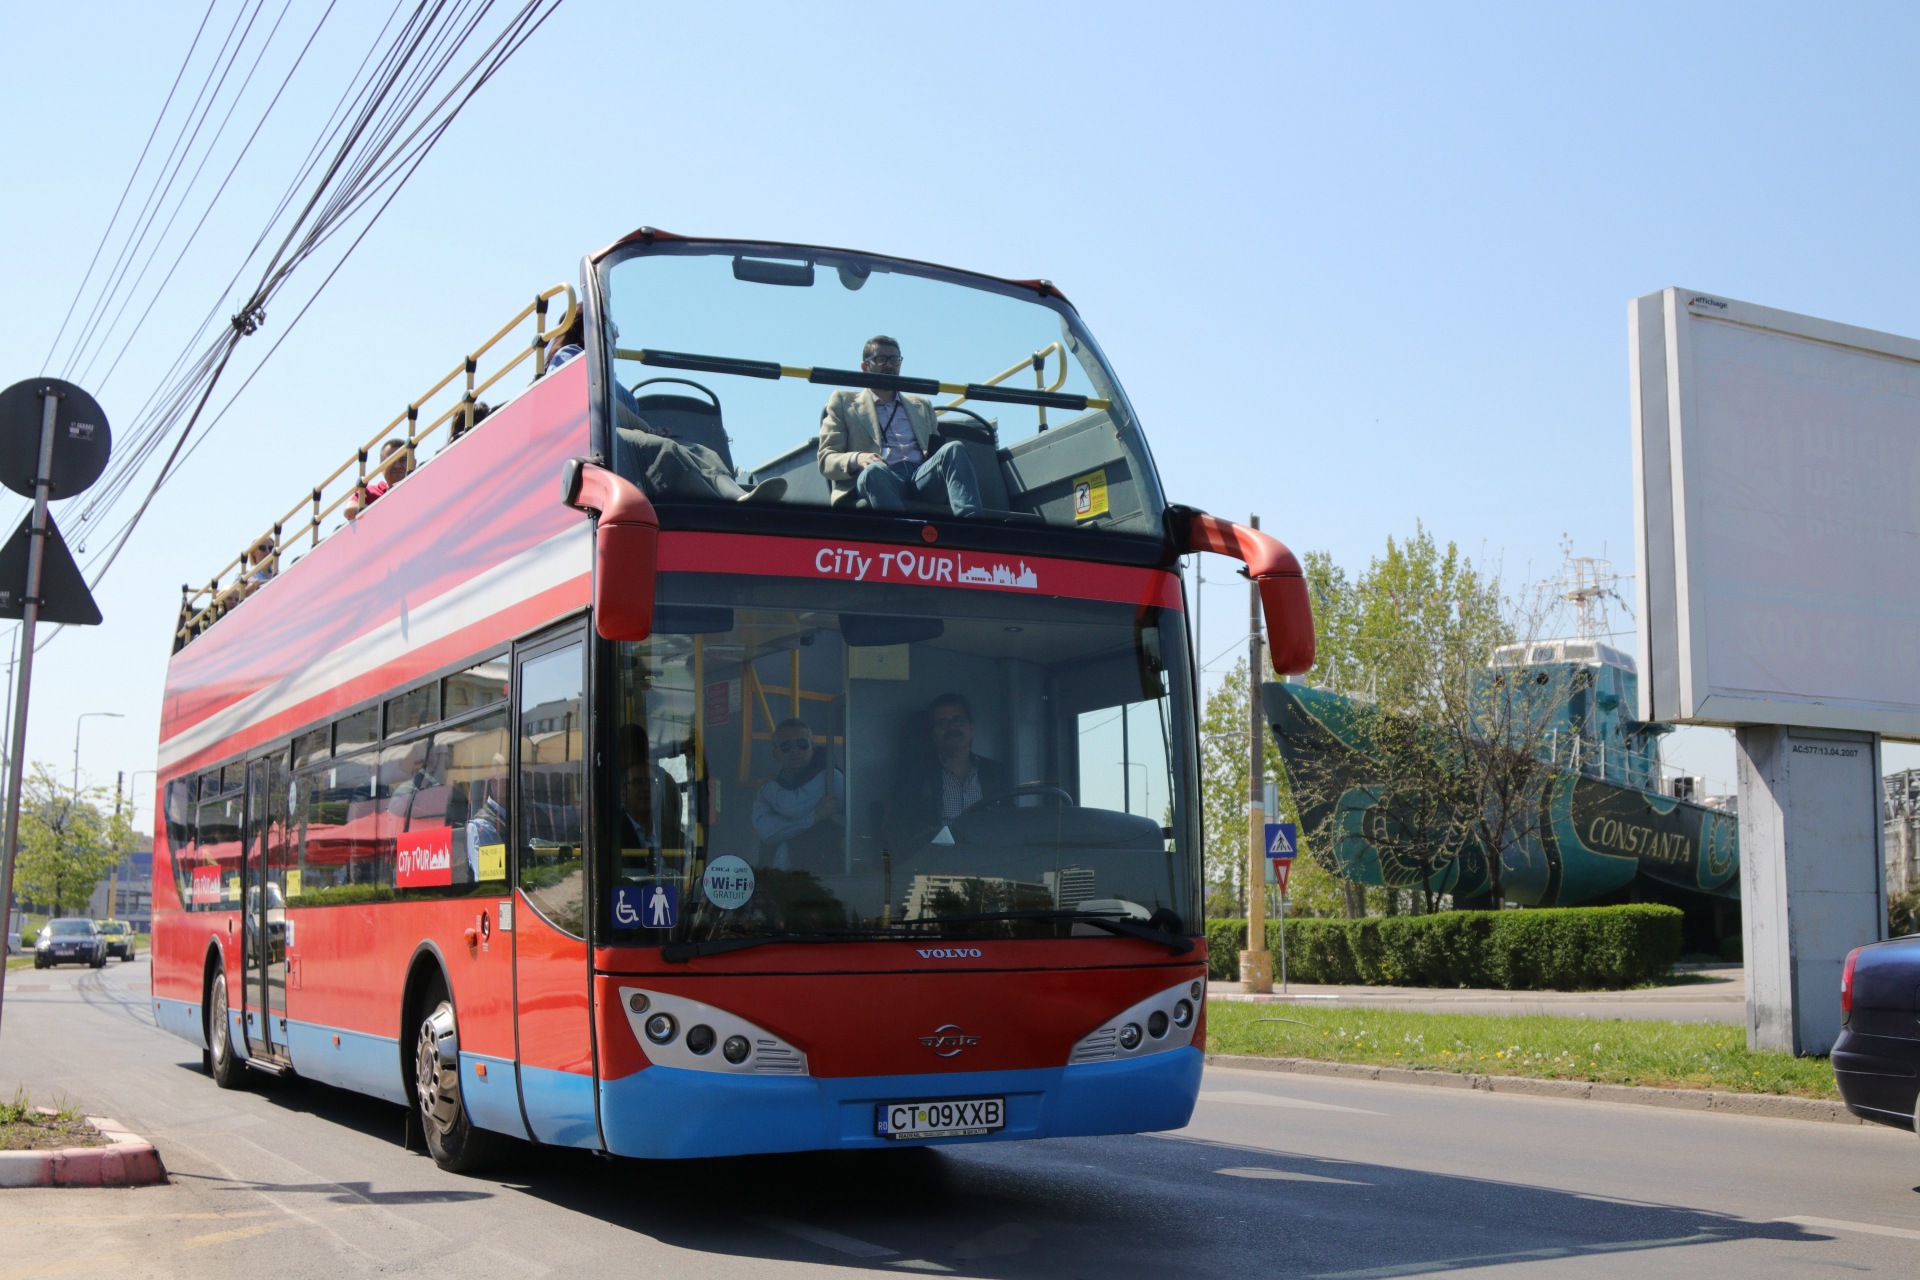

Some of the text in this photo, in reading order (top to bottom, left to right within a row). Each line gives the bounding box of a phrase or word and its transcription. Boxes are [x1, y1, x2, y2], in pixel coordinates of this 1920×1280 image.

[879, 550, 953, 582] TOUR
[711, 876, 747, 891] Wi-Fi
[713, 891, 745, 899] GRATUIT
[916, 948, 982, 959] VOLVO
[878, 1121, 888, 1131] RO
